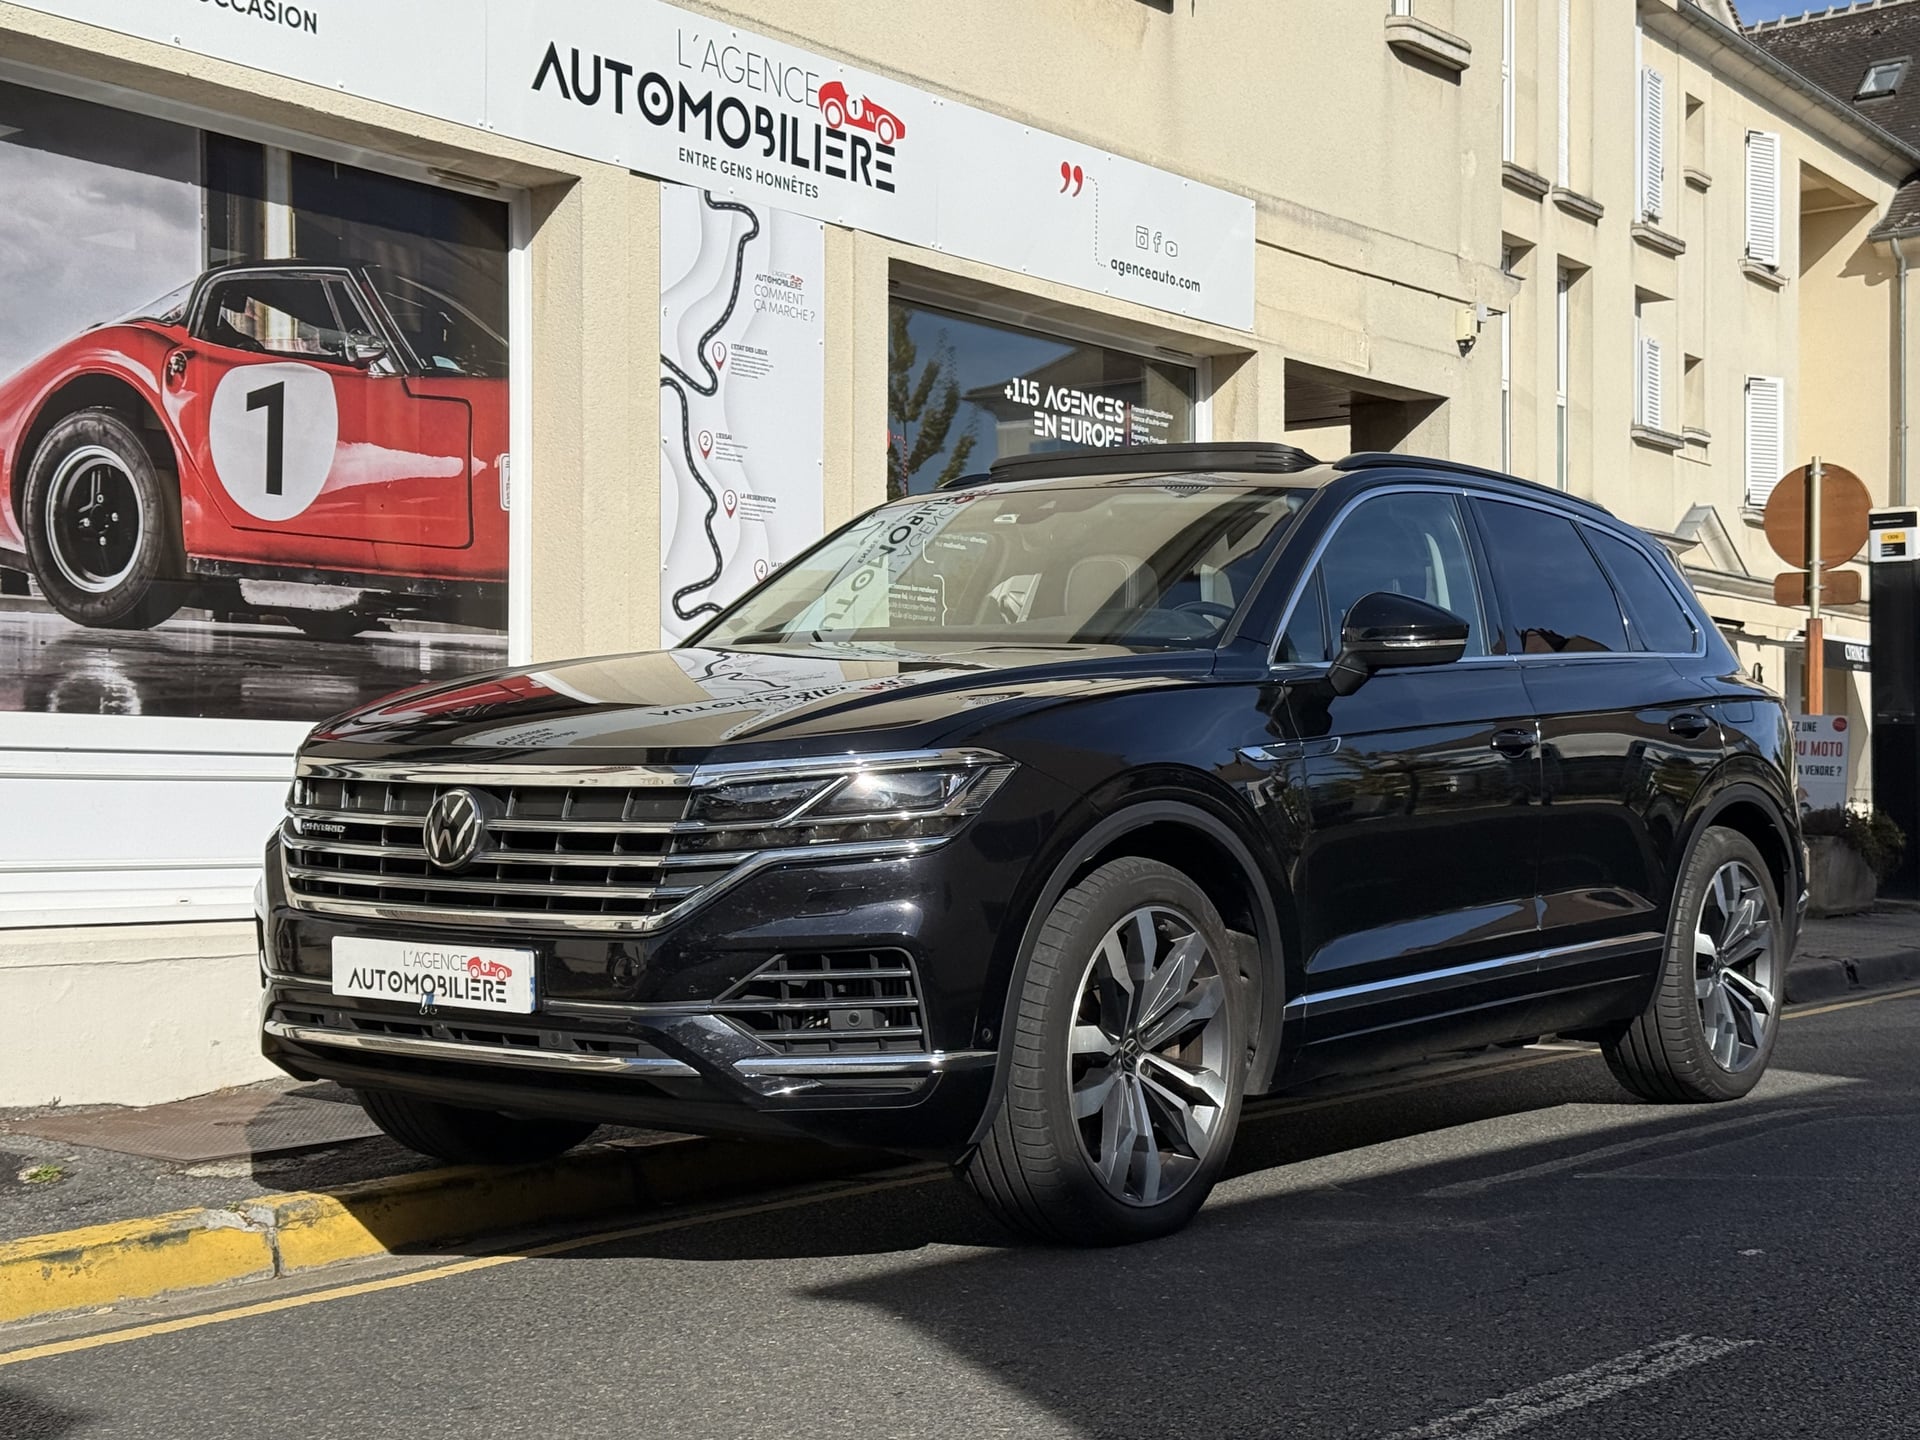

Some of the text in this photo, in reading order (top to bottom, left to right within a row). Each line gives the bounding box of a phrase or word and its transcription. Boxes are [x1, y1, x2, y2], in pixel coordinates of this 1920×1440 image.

[678, 28, 820, 109] L'AGENCE
[679, 147, 819, 199] ENTRE GENS HONNÊTES
[1110, 258, 1201, 292] agenceauto.com
[754, 284, 805, 305] COMMENT
[769, 302, 808, 321] MARCHE
[1004, 377, 1124, 424] +115 AGENCES
[246, 381, 284, 496] 1
[1034, 411, 1124, 448] EN EUROPE
[703, 435, 709, 446] 2
[728, 494, 733, 505] 3
[1802, 722, 1816, 732] UNE
[1810, 741, 1843, 757] MOTO
[1804, 765, 1834, 776] VENDRE
[402, 950, 468, 972] L'AGENCE
